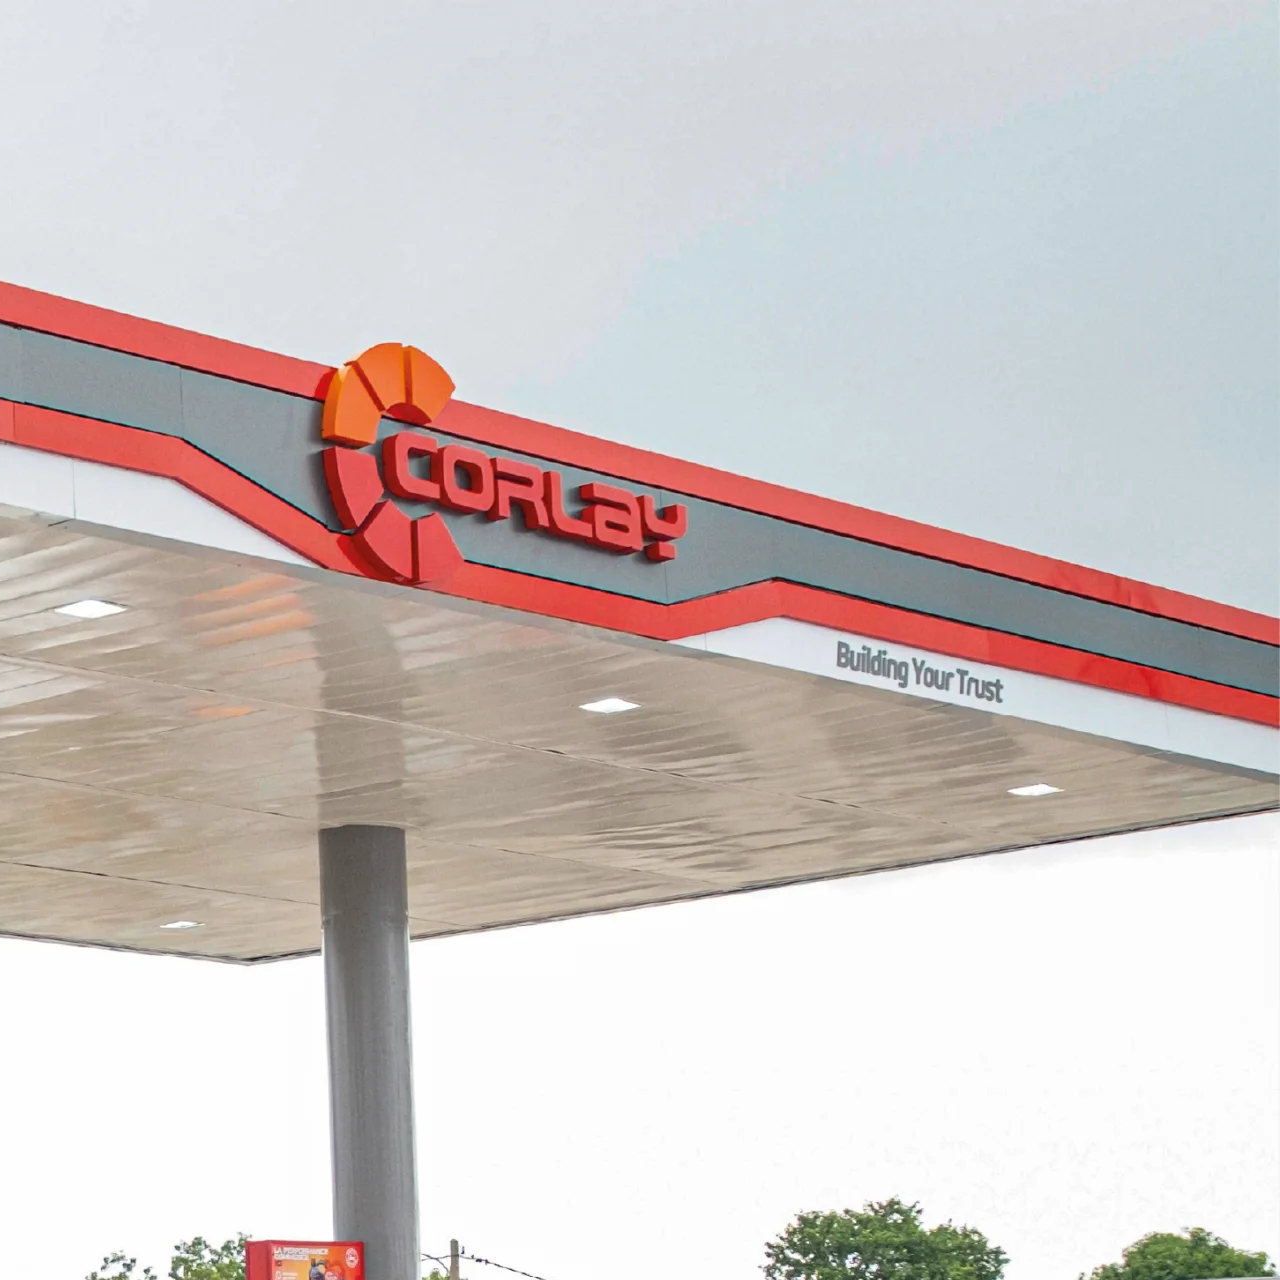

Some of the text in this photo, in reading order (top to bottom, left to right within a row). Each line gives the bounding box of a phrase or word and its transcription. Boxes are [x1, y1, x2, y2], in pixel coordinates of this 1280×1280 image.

[382, 430, 688, 562] CORLAY
[836, 640, 1004, 703] Building Your Trust
